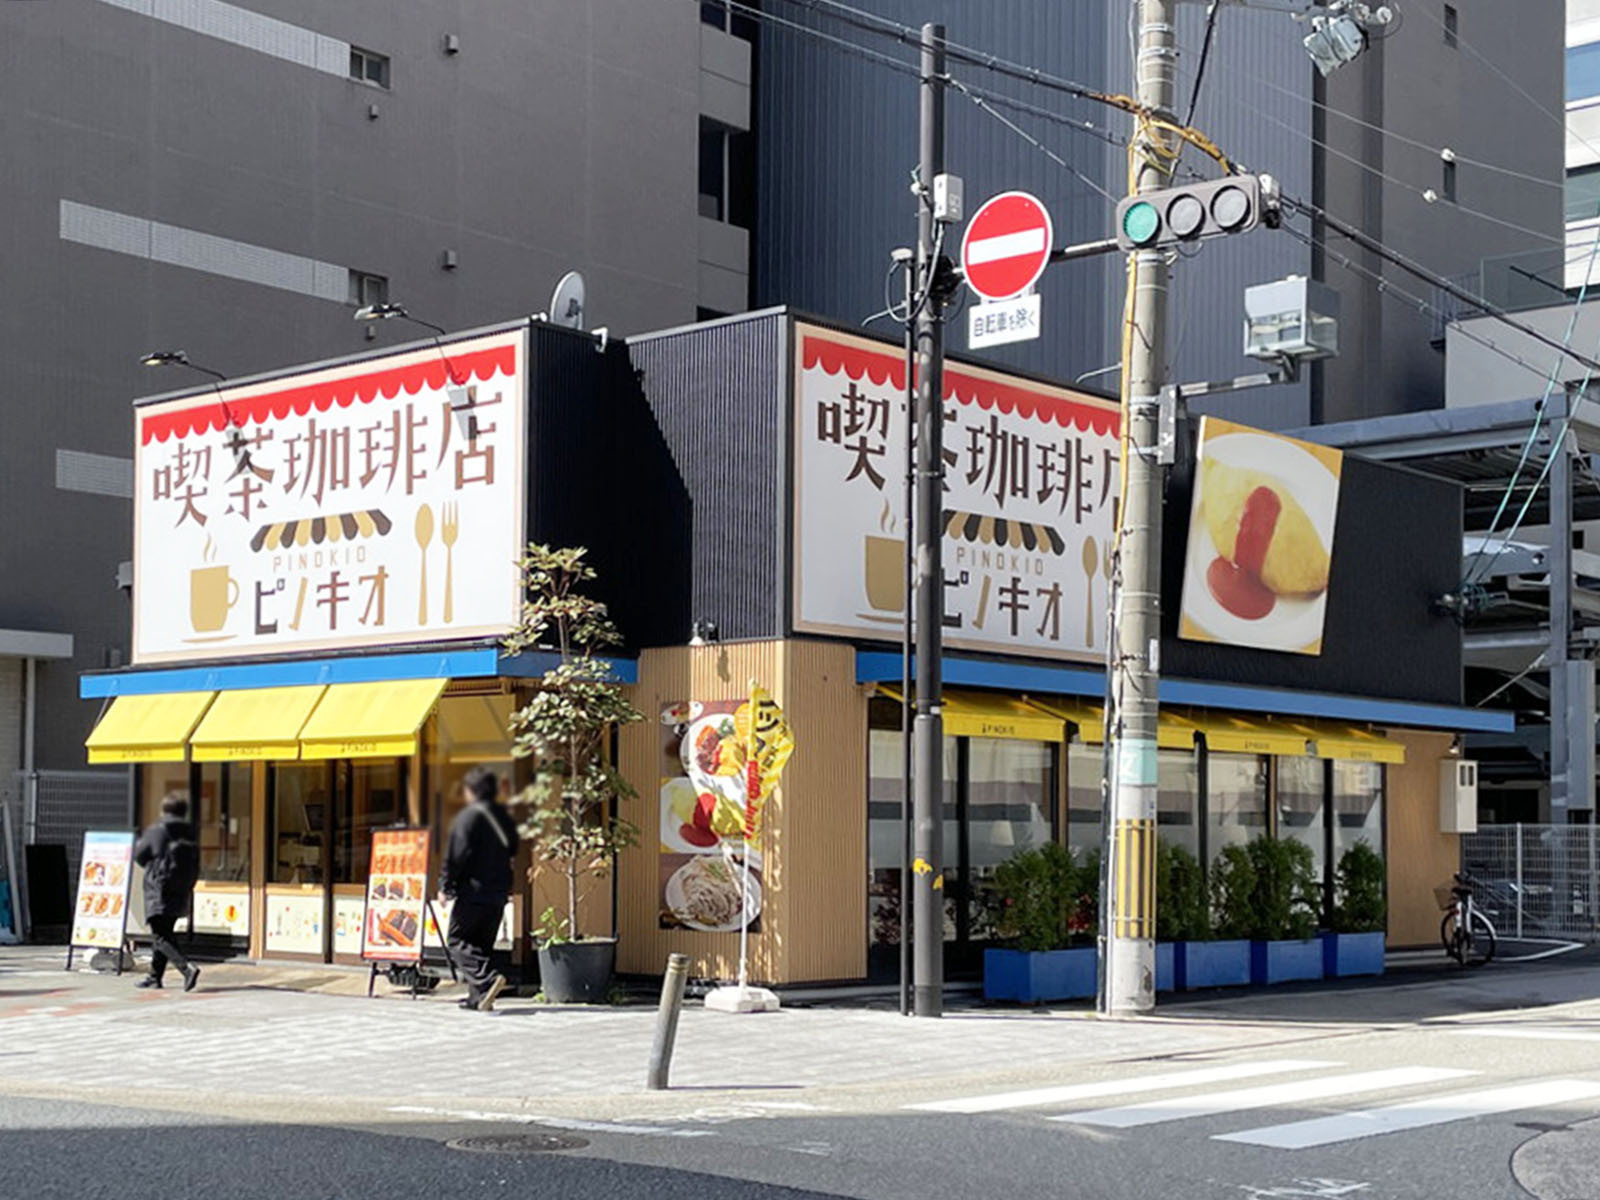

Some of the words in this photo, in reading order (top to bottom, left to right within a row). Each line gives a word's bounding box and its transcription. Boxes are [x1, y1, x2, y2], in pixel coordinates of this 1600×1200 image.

[152, 385, 502, 528] 喫茶珈琲店
[273, 545, 366, 573] PINOKIO
[957, 547, 1043, 576] PINOKIO
[255, 565, 389, 635] ピノキオ
[941, 568, 1063, 640] ピノキオ
